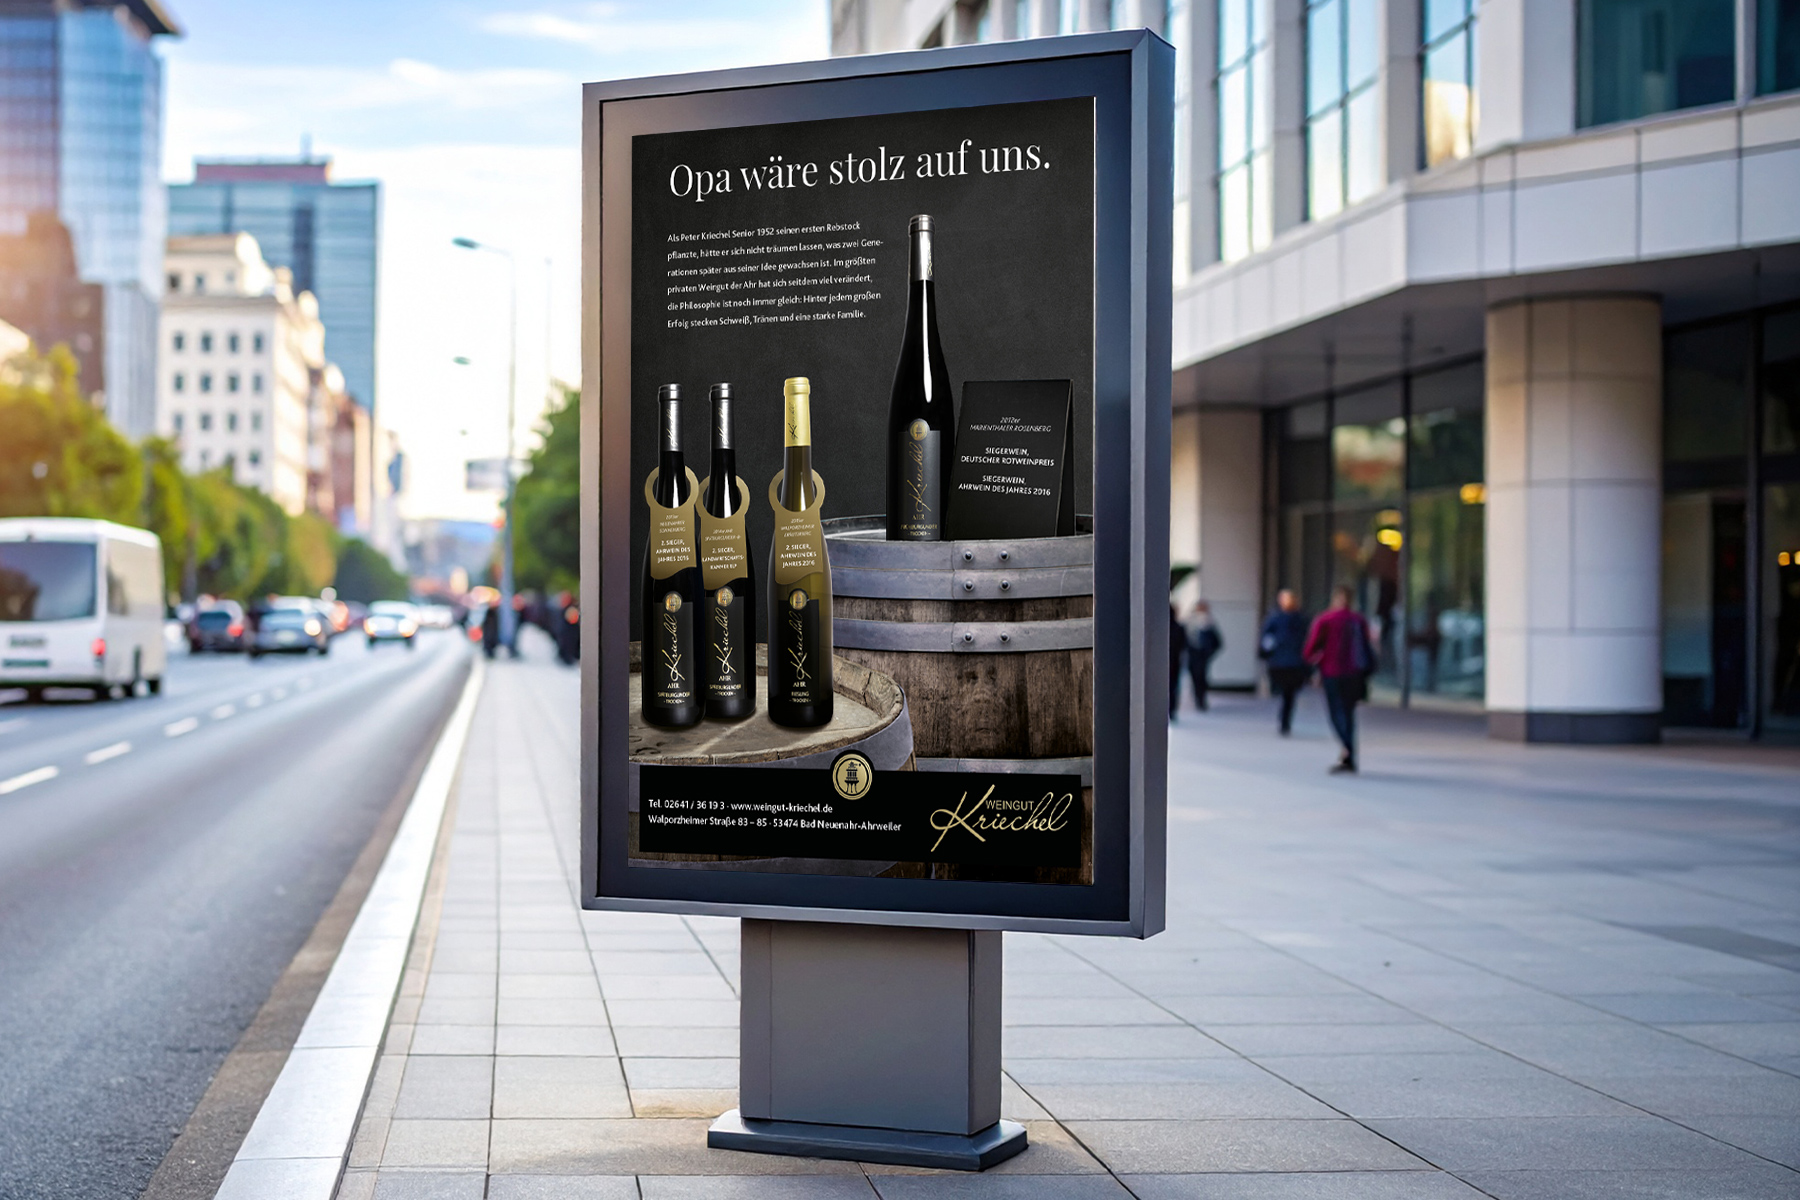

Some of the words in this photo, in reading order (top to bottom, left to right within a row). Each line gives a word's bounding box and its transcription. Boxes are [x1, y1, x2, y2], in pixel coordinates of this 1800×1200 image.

[669, 164, 733, 202] Opa
[740, 156, 818, 191] wäre
[829, 146, 906, 186] stolz
[916, 138, 973, 179] auf
[979, 143, 1051, 174] uns.
[667, 234, 680, 242] Als
[680, 233, 700, 241] Peter
[701, 230, 730, 240] Kriechel
[732, 229, 755, 238] Senior
[757, 227, 774, 236] 1952
[776, 227, 800, 235] seinen
[801, 226, 825, 234] ersten
[826, 221, 860, 231] Rebstock
[667, 251, 699, 262] pflanzte,
[700, 249, 720, 258] hätte
[731, 246, 745, 256] sich
[746, 246, 765, 254] nicht
[766, 245, 798, 253] träumen
[799, 243, 825, 251] lassen,
[842, 240, 859, 248] zwei
[861, 238, 884, 247] Gene-
[667, 269, 698, 277] rationen
[699, 267, 722, 277] später
[724, 266, 736, 274] aus
[738, 264, 759, 273] seiner
[761, 262, 777, 271] Idee
[778, 260, 819, 272] gewachsen
[820, 260, 832, 268] ist.
[834, 259, 844, 267] Im
[845, 257, 876, 269] größten
[667, 285, 697, 296] privaten
[698, 283, 729, 293] Weingut
[730, 281, 742, 289] der
[743, 280, 757, 289] Ahr
[759, 280, 770, 288] hat
[772, 278, 786, 287] sich
[788, 277, 817, 286] seitdem
[819, 276, 832, 284] viel
[834, 274, 872, 283] verändert,
[668, 302, 678, 310] die
[680, 300, 720, 311] Philosophie
[722, 299, 732, 308] ist
[733, 298, 751, 307] noch
[753, 298, 776, 306] immer
[777, 295, 802, 307] gleich:
[803, 294, 828, 303] Hinter
[828, 293, 852, 304] jedem
[853, 291, 881, 303] großen
[668, 319, 688, 330] Erfolg
[691, 318, 718, 327] stecken
[720, 315, 752, 325] Schweiß,
[753, 315, 778, 323] Tränen
[780, 313, 794, 322] und
[795, 312, 811, 321] eine
[813, 311, 835, 320] starke
[837, 310, 866, 319] Familie.
[961, 455, 1000, 464] DEUTSCHER
[1002, 457, 1055, 466] ROTWEINPREIS
[985, 447, 1029, 456] SIEGERWEIN,
[958, 483, 990, 491] AHRWEIN
[992, 485, 1005, 493] DES
[1005, 487, 1031, 495] JAHRES
[1033, 488, 1051, 496] 2016
[648, 799, 662, 808] Tel.
[664, 800, 689, 809] 02641
[696, 801, 707, 809] 36
[709, 801, 718, 810] 19
[720, 801, 725, 810] 3
[731, 803, 833, 814] www.weingut-kriechel.de
[986, 800, 1034, 810] WEINGUT
[648, 815, 708, 826] Walporzheimer
[710, 817, 736, 827] Straße
[738, 818, 748, 826] 83
[756, 818, 767, 827] 85
[773, 819, 798, 828] 53474
[800, 820, 816, 828] Bad
[818, 820, 901, 831] Neuenahr-Ahrweiler
[930, 784, 1073, 852] Kriechel
